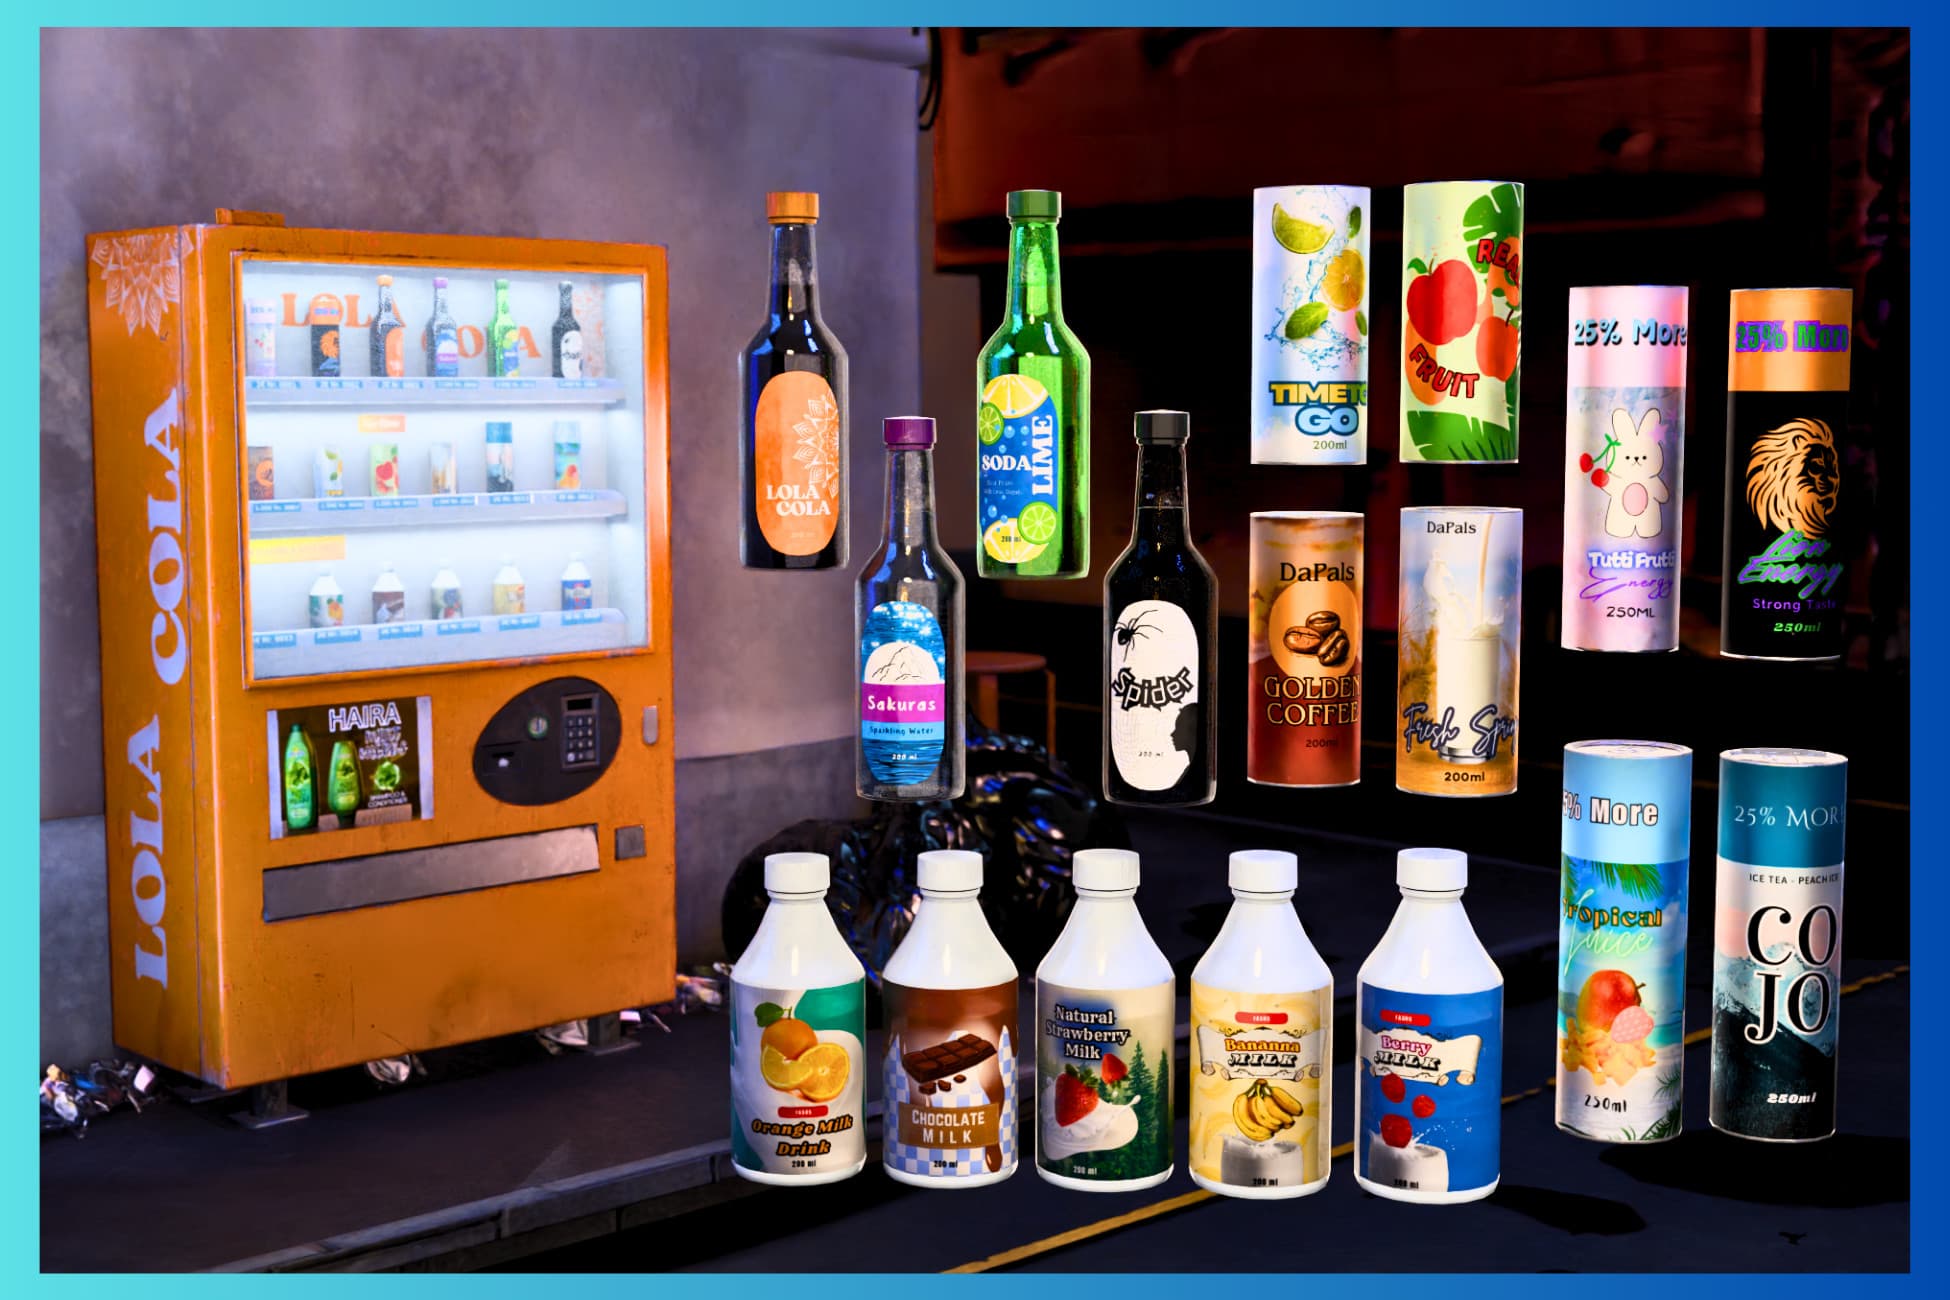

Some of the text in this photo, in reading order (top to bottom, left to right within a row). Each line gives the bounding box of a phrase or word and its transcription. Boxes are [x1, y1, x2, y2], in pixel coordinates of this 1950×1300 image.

[1476, 239, 1519, 288] REA
[421, 324, 542, 360] OA
[1574, 317, 1622, 346] 25%
[1736, 320, 1787, 352] 25%
[1409, 343, 1479, 398] FRUIT
[1295, 404, 1359, 436] GO
[1032, 414, 1053, 496] LIME
[1312, 439, 1348, 450] 200ml
[982, 455, 1033, 471] SODA
[767, 484, 820, 500] LOLA
[776, 501, 831, 516] COLA
[1426, 520, 1478, 535] DaPals
[1588, 551, 1633, 568] Tutti
[1280, 562, 1355, 583] DaPals
[1738, 562, 1843, 599] Energy
[1579, 567, 1673, 602] Energy
[1606, 606, 1656, 618] 250ML
[1752, 597, 1801, 613] Strong
[1773, 622, 1821, 632] 250ml
[127, 388, 185, 989] LOLA COLA
[1112, 666, 1194, 712] Spider
[1264, 676, 1361, 700] GOLDEN
[867, 695, 936, 711] Sakuras
[328, 702, 402, 733] HAIRA
[1267, 702, 1359, 726] COFFEE
[870, 725, 934, 736] Sparkling Water
[1403, 702, 1460, 753] Fresh
[1444, 772, 1485, 782] 200ml
[1562, 789, 1659, 827] 5% More
[1734, 804, 1844, 831] 25% MOR
[1749, 874, 1765, 883] ICE
[1769, 875, 1788, 884] TEA
[1798, 875, 1828, 885] PEACH
[1745, 903, 1838, 968] CO
[1054, 1003, 1116, 1025] Natural
[1744, 969, 1832, 1045] JO
[1045, 1021, 1131, 1046] Strawberry
[1064, 1043, 1101, 1060] Milk
[1224, 1038, 1301, 1053] Bananna
[1381, 1035, 1432, 1057] Berry
[1228, 1053, 1298, 1067] MILK
[1374, 1051, 1441, 1071] MILK
[1584, 1094, 1627, 1112] 250ml
[1767, 1092, 1816, 1104] 250ml
[752, 1114, 854, 1139] Orange Milk
[912, 1109, 985, 1127] CHOCOLATE
[923, 1128, 972, 1144] MILK
[776, 1139, 831, 1156] Drink
